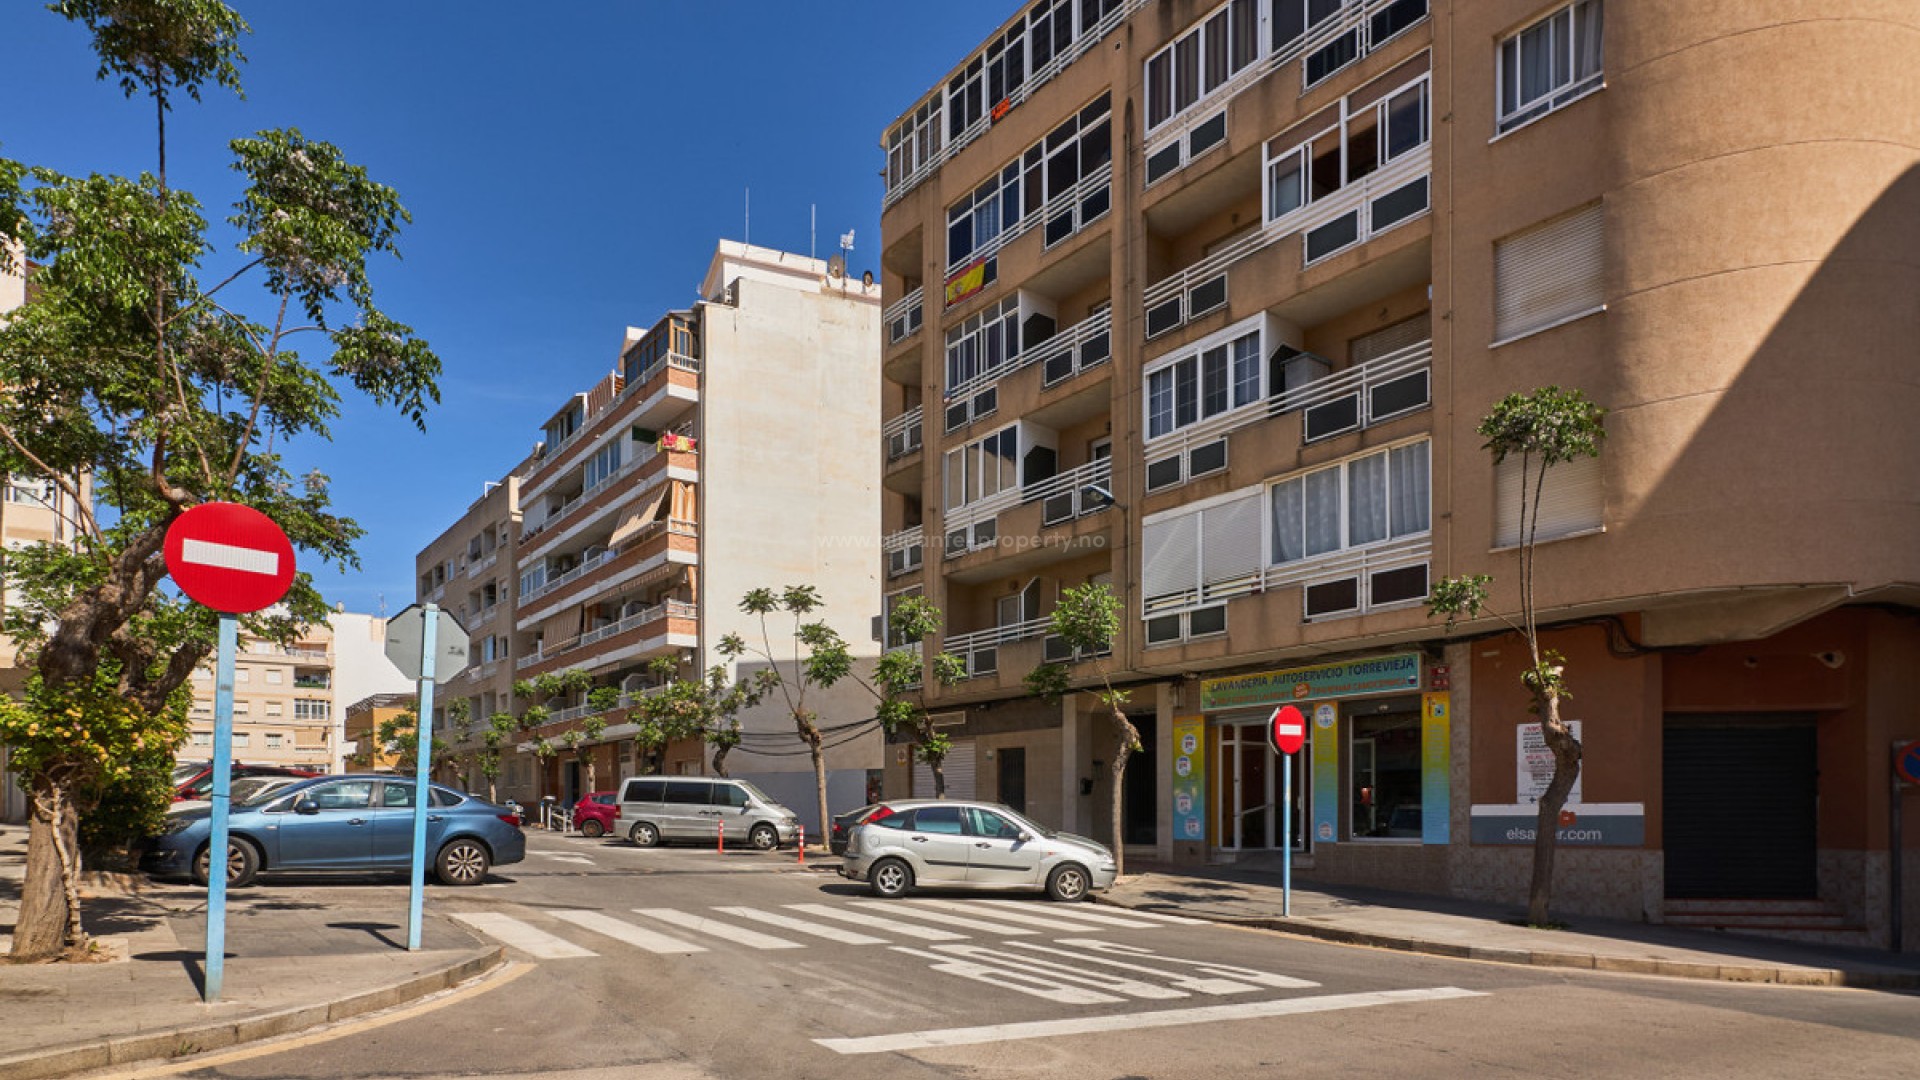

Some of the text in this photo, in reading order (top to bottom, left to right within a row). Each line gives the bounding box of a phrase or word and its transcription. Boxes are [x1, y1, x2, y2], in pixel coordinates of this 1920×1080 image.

[1272, 667, 1343, 685] AUTOSERVICIO
[1347, 657, 1414, 676] TORREVIEJA
[887, 939, 1323, 1004] STOP
